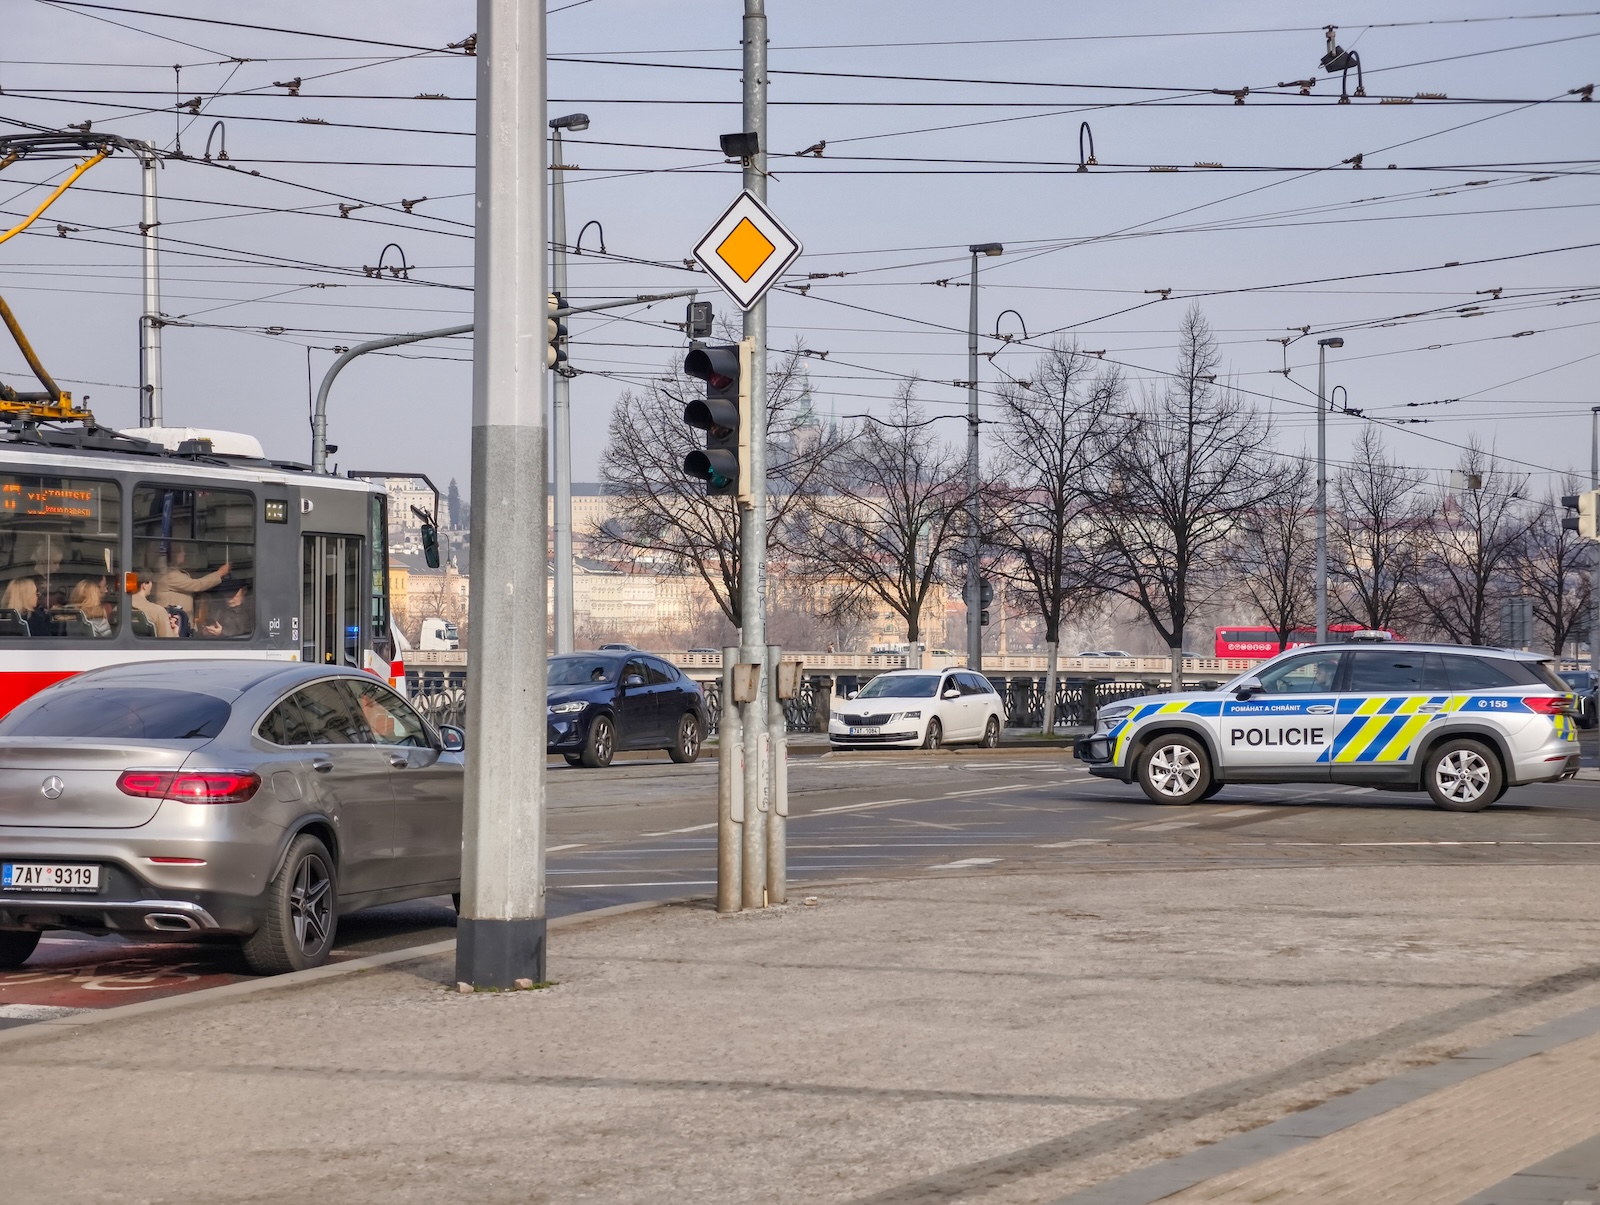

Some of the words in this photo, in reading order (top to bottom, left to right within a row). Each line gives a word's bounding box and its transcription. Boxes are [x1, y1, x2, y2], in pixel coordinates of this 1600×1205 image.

[742, 155, 750, 167] B
[269, 617, 280, 631] pid
[1489, 700, 1508, 708] 158
[1231, 727, 1324, 746] POLICIE
[15, 867, 42, 883] 7AY
[54, 868, 91, 885] 9319
